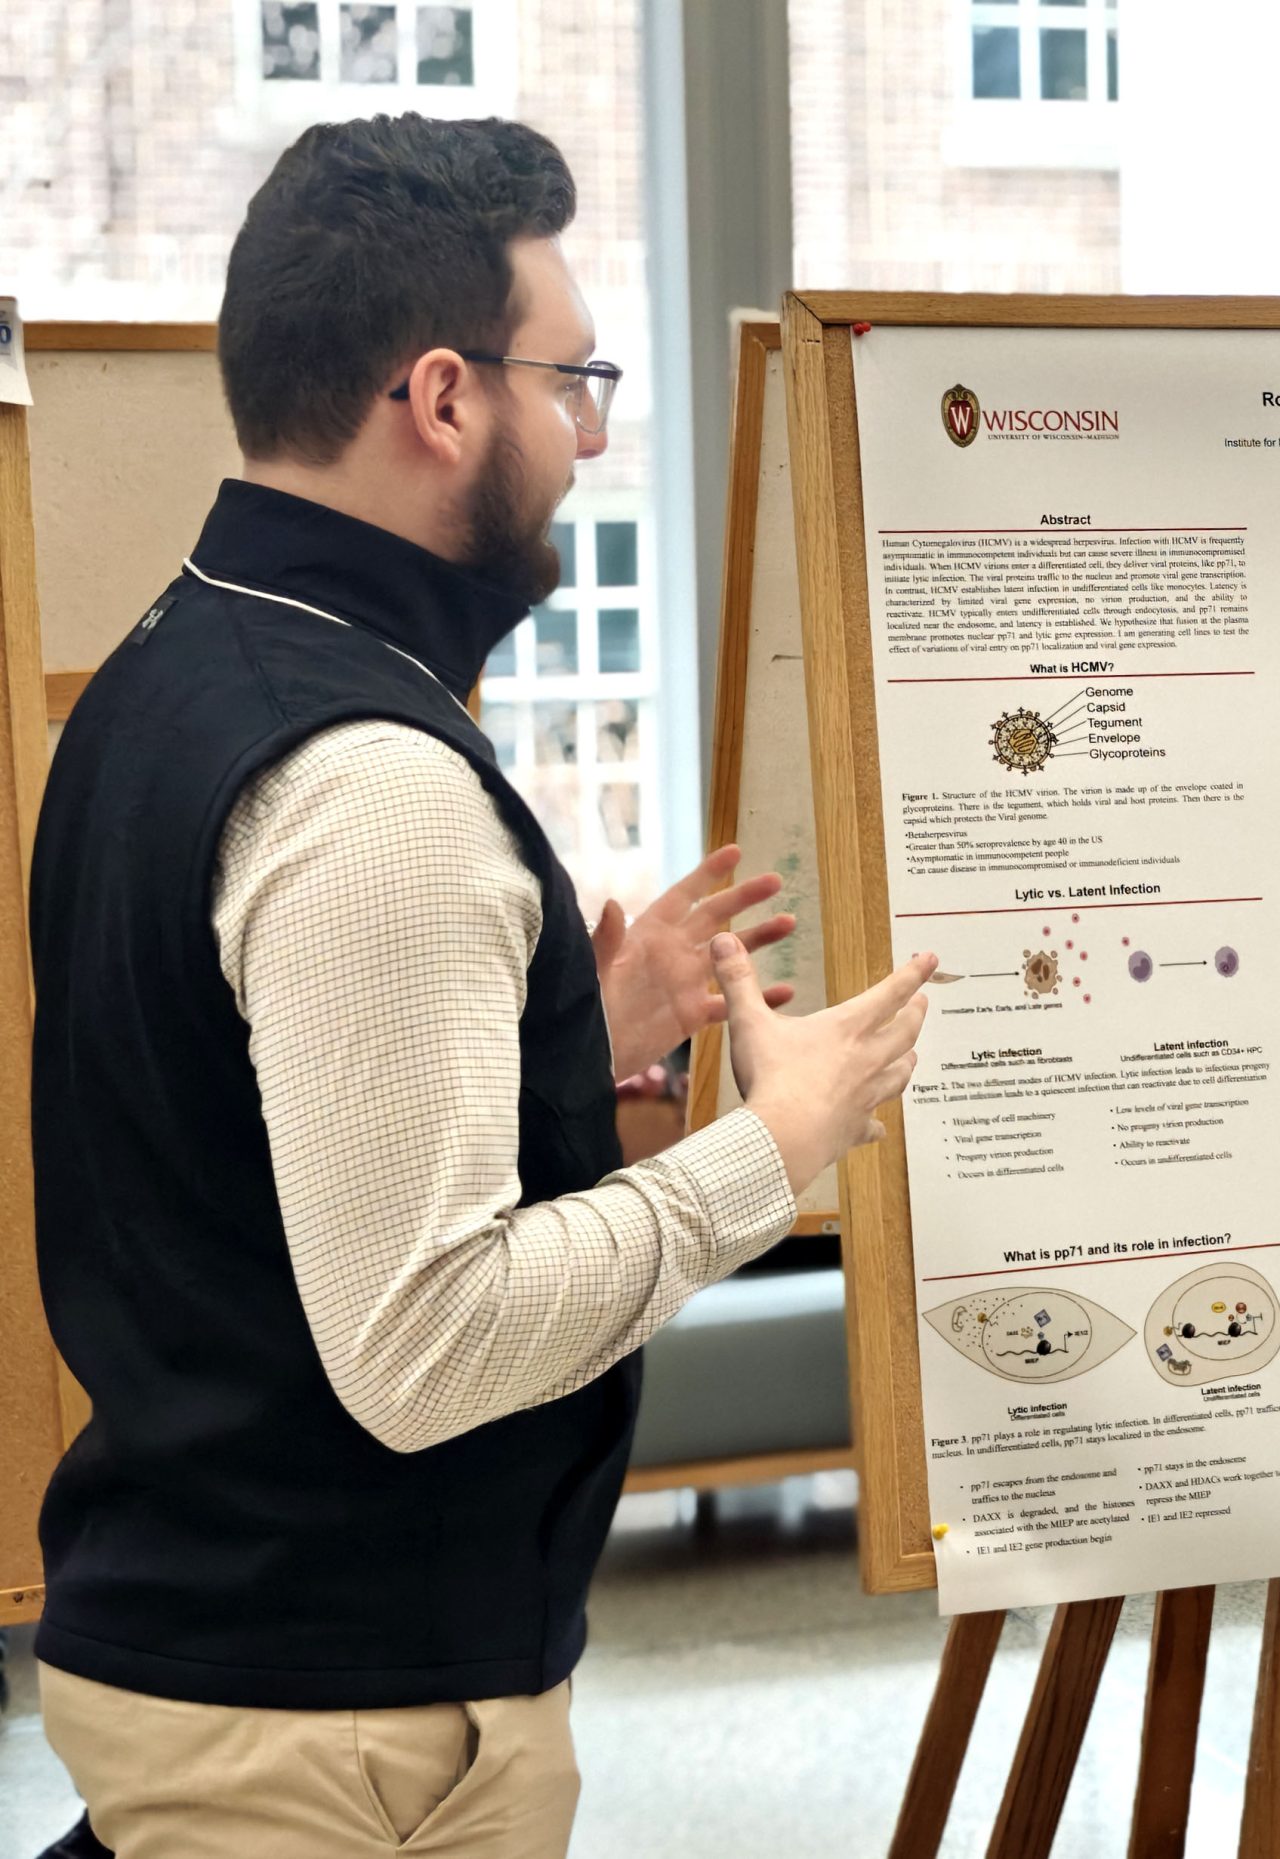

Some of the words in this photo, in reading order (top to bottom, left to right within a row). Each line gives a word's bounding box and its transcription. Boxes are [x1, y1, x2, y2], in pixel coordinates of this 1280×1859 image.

[951, 407, 971, 435] W
[983, 410, 1118, 431] WISCONSIN
[1224, 438, 1261, 447] Institute
[1263, 437, 1276, 447] for
[1040, 514, 1091, 525] Abstract
[1029, 663, 1056, 673] What
[1059, 663, 1068, 672] is
[1071, 661, 1114, 672] HCMV?
[1085, 686, 1133, 697] Genome
[1086, 701, 1125, 714] Capsid
[1088, 717, 1143, 730] Tegument
[1088, 732, 1140, 744] Envelope
[1089, 747, 1166, 761] Glycoproteins
[1015, 888, 1044, 902] Lytic
[1047, 889, 1065, 898] vs.
[1068, 885, 1106, 897] Latent
[1109, 882, 1160, 895] Infection
[1153, 1041, 1184, 1051] Latent
[1186, 1039, 1228, 1049] infection
[971, 1050, 995, 1061] Lytic
[998, 1047, 1042, 1057] infection
[1003, 1249, 1036, 1262] What
[1039, 1248, 1050, 1259] is
[1054, 1245, 1083, 1261] pp71
[1087, 1242, 1110, 1255] and
[1113, 1242, 1128, 1252] its
[1131, 1239, 1154, 1251] role
[1158, 1238, 1169, 1249] in
[1172, 1232, 1231, 1248] infection?
[1200, 1386, 1226, 1395] Latent
[1227, 1383, 1261, 1392] infection
[1007, 1406, 1028, 1416] Lytic
[1030, 1402, 1067, 1412] infection
